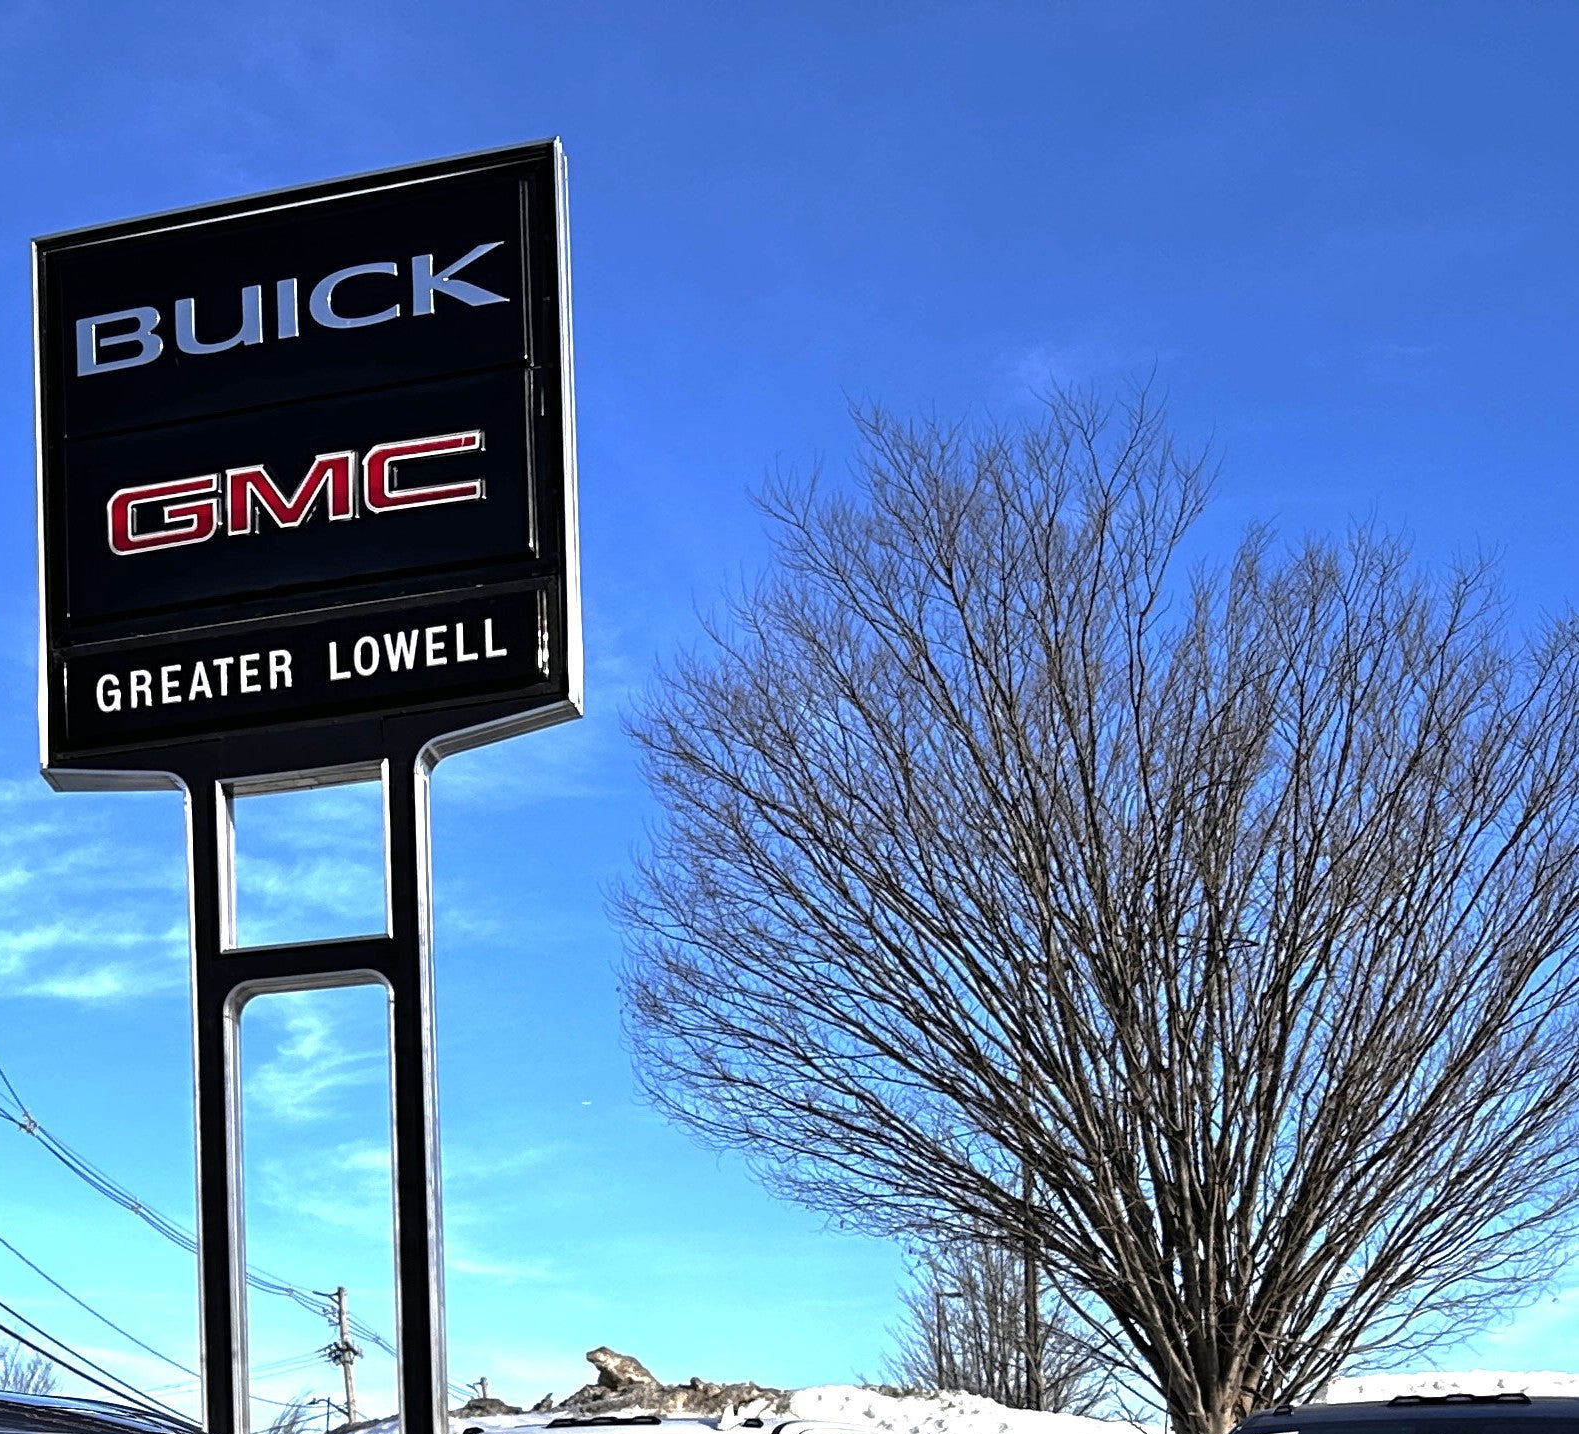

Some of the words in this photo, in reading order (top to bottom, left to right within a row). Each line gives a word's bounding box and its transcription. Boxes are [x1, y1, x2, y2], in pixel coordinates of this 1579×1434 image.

[75, 240, 510, 377] BUICK
[107, 430, 486, 556] GMC
[95, 649, 294, 713] GREATER
[328, 618, 508, 681] LOWELL
